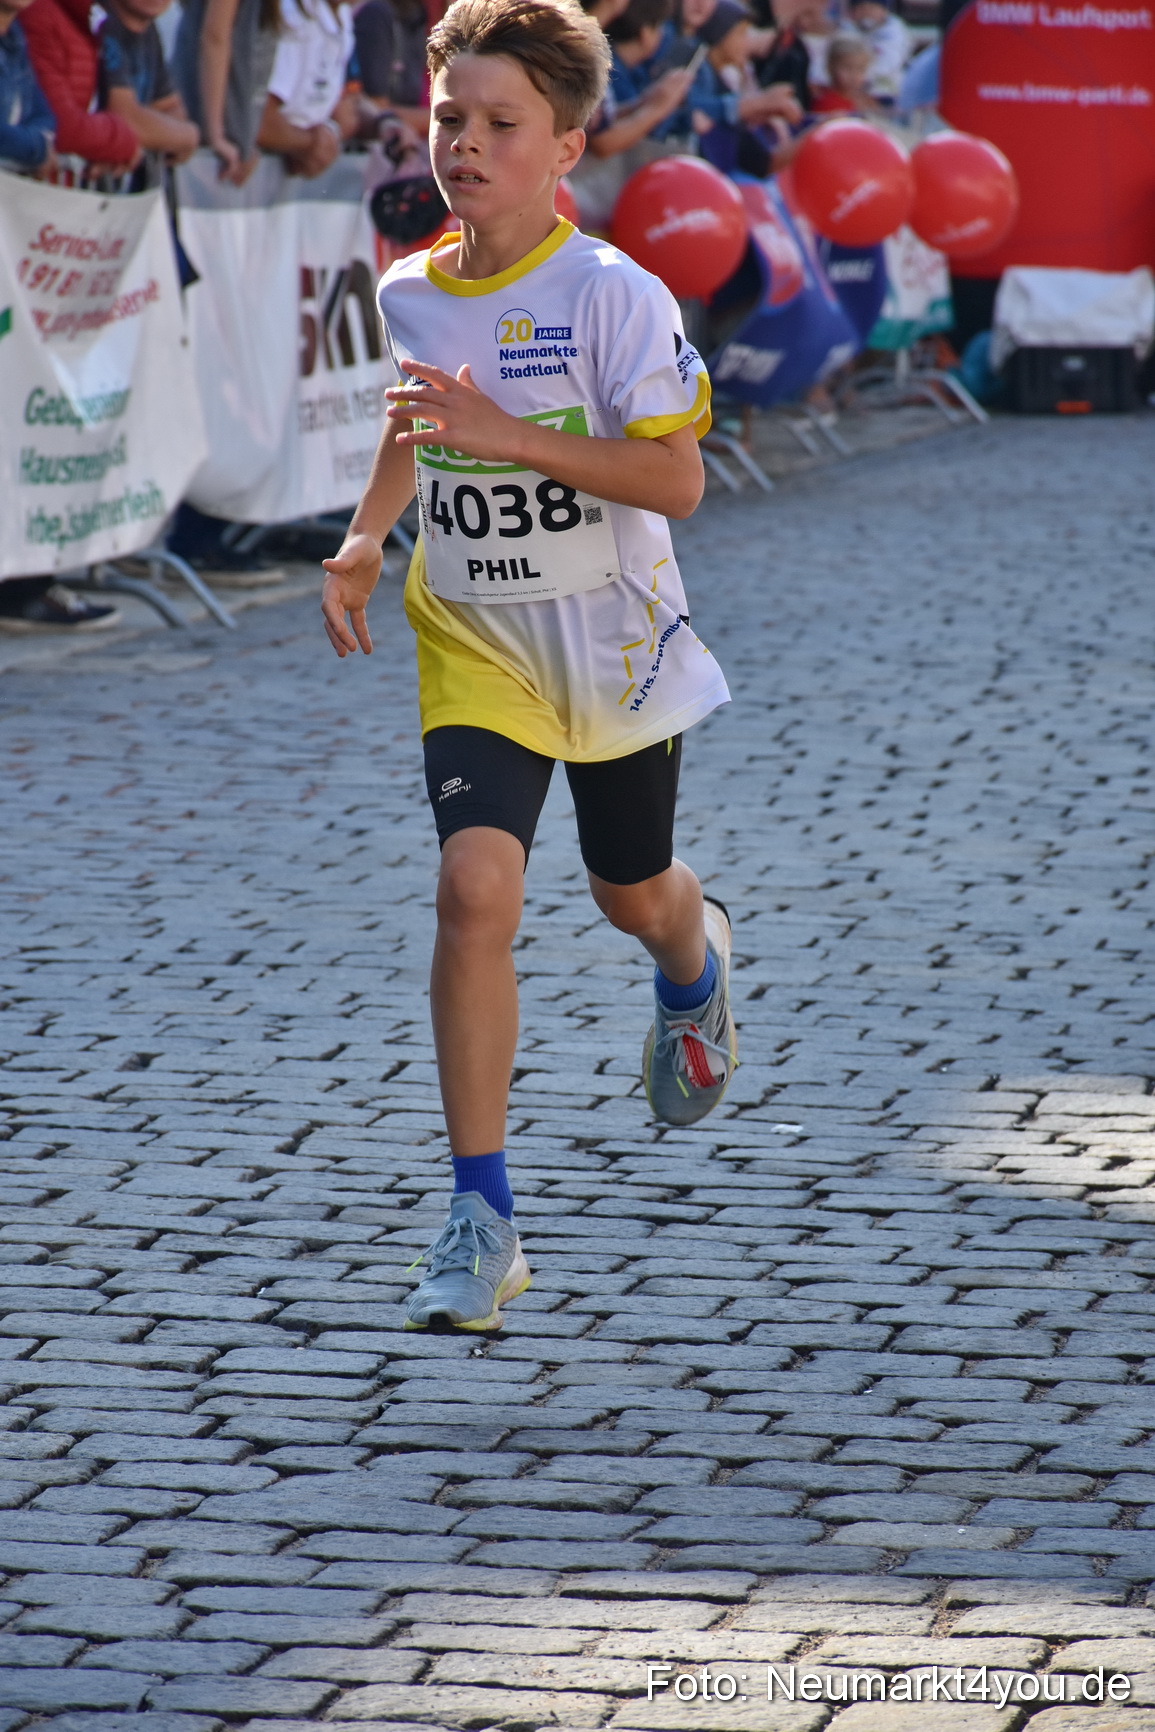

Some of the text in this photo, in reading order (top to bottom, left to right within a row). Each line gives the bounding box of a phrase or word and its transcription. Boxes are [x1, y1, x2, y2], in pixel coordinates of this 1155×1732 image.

[499, 318, 570, 344] 20 JAHRE
[499, 344, 579, 361] Neumarkte
[500, 361, 569, 379] Stadtlauf
[431, 478, 582, 540] 4038
[467, 557, 541, 581] PHIL
[651, 616, 682, 673] Septembe
